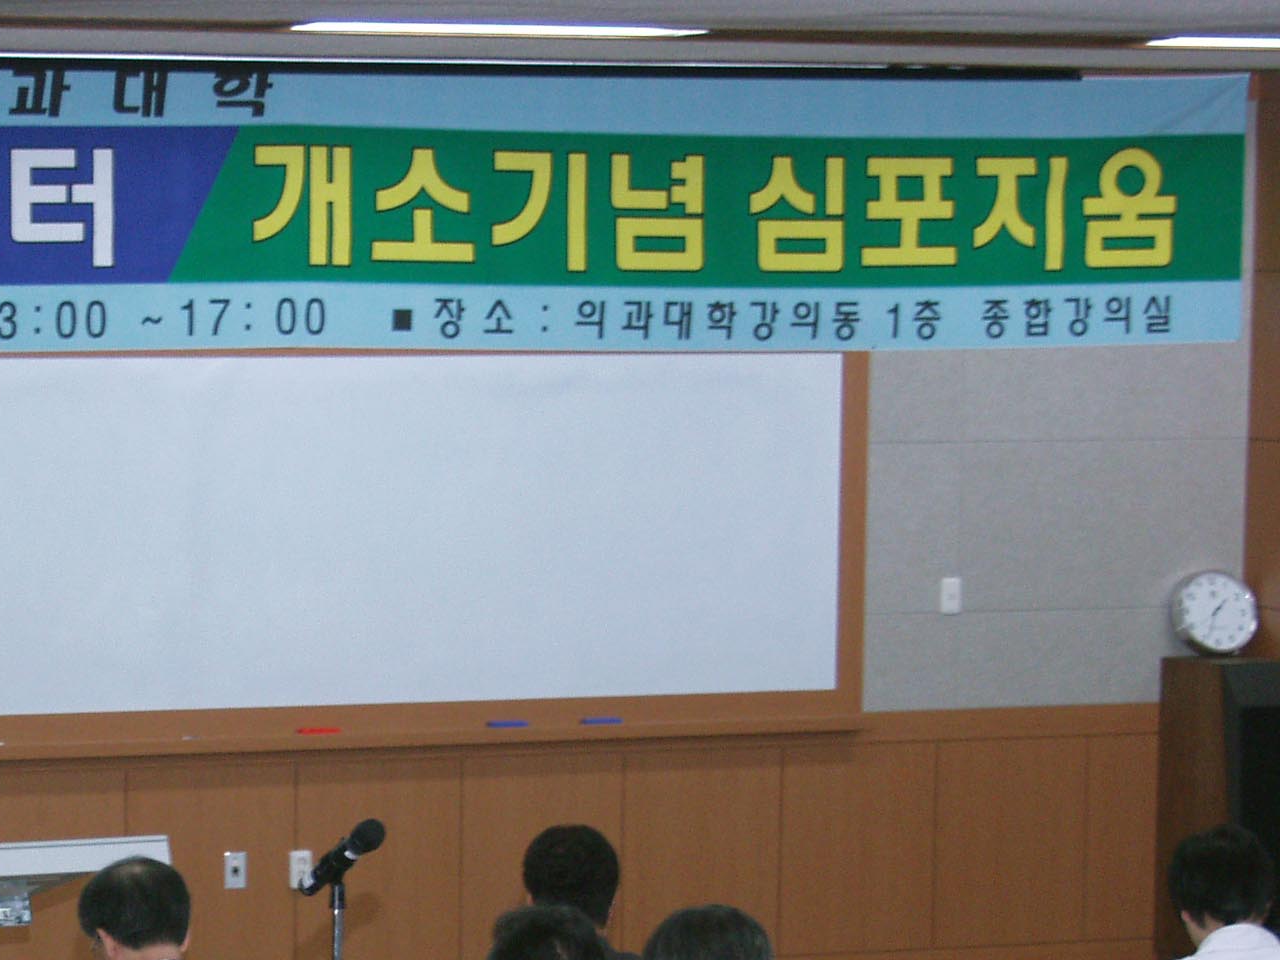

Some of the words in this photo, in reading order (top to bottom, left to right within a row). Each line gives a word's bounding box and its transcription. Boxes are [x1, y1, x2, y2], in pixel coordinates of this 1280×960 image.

[251, 144, 706, 272] 개소기념
[748, 147, 1177, 273] 심포지움
[980, 294, 1172, 340] 종합강의실
